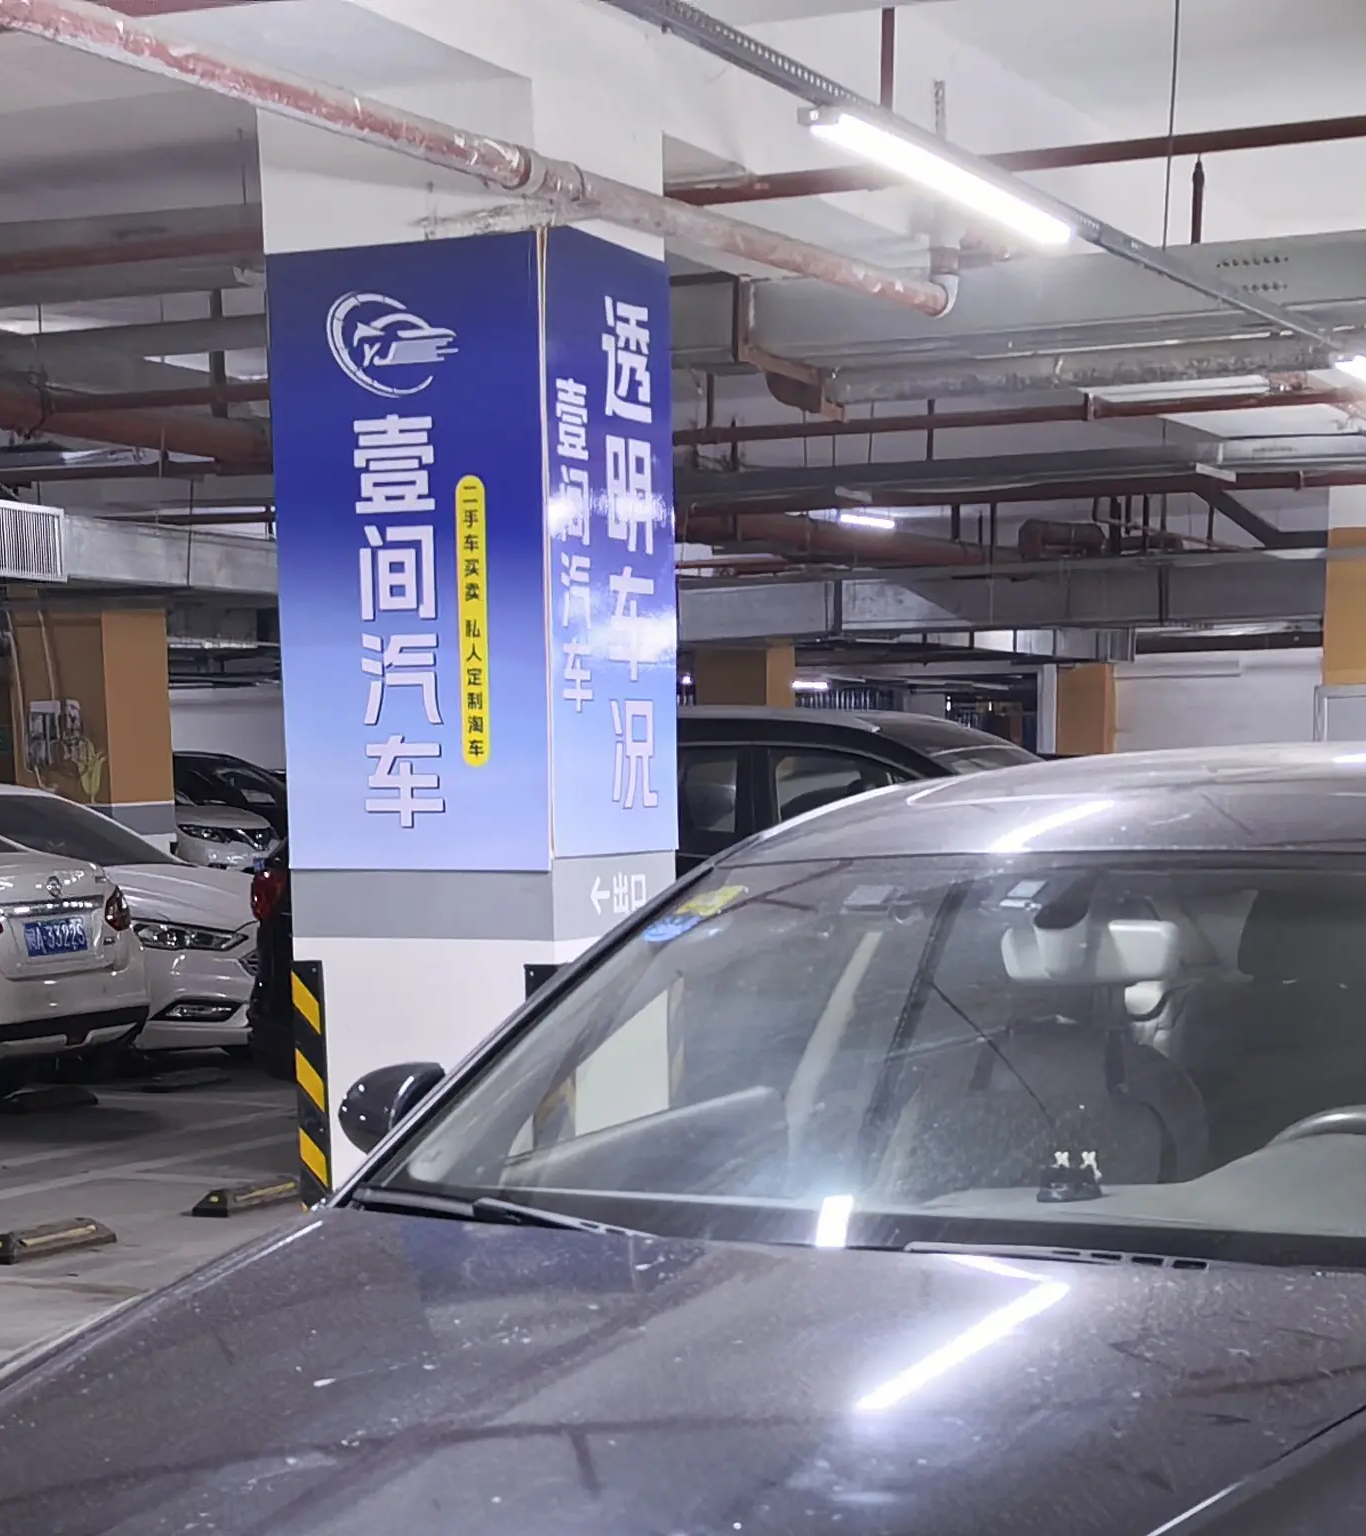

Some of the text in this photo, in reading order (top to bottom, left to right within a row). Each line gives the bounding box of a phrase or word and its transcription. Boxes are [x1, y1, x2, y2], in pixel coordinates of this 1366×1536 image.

[353, 414, 446, 828] 壹间汽车
[462, 485, 485, 758] 二手车买卖 私人定制淘车
[555, 378, 595, 713] 壹间汽车
[602, 296, 657, 809] 透明车况
[613, 872, 647, 914] 出口
